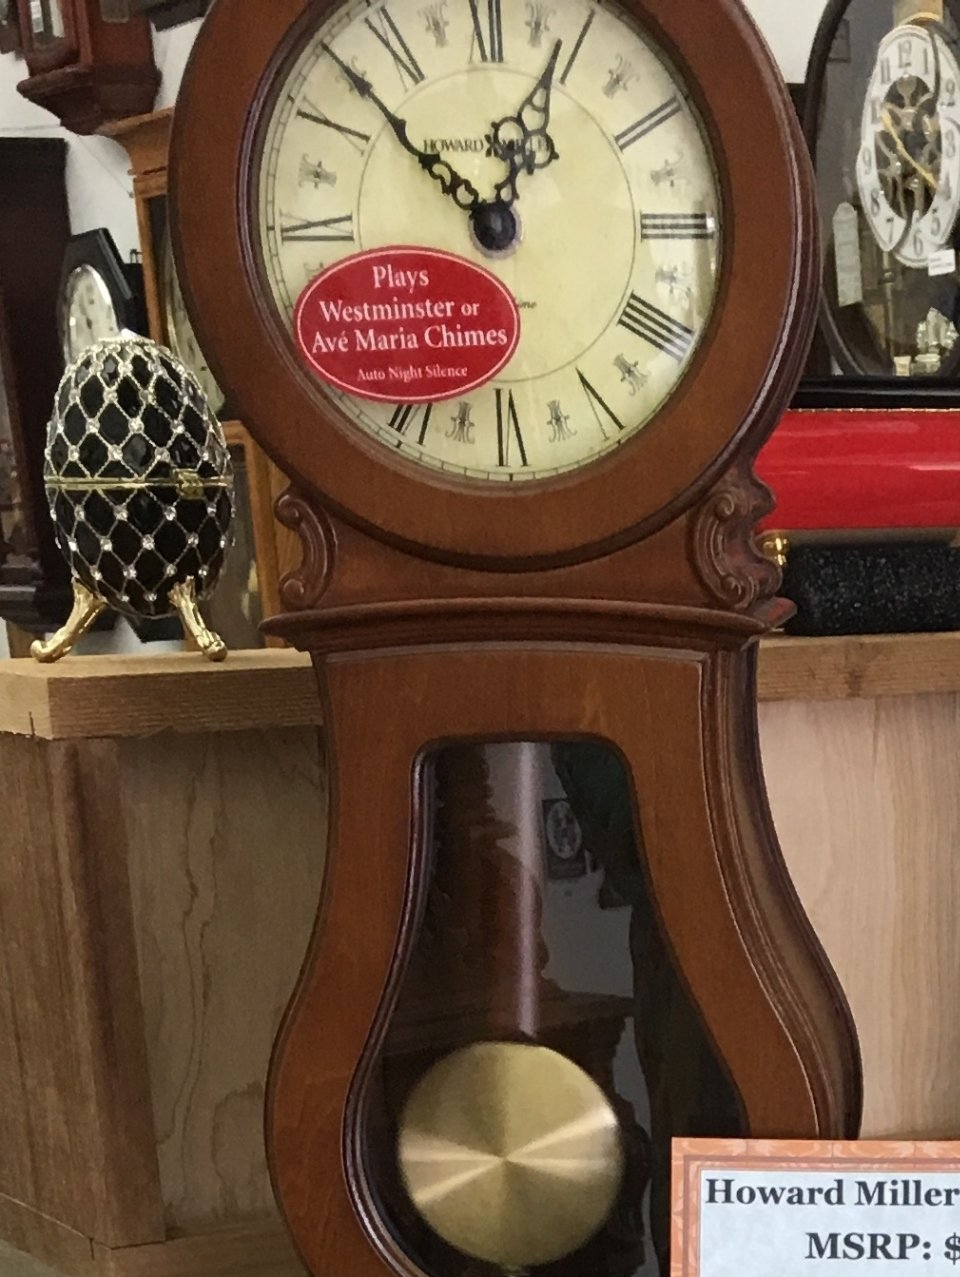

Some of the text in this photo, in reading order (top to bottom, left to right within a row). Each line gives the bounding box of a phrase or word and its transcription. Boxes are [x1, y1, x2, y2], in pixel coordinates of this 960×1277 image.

[423, 139, 484, 152] HOWARD
[372, 264, 429, 294] Plays
[319, 296, 480, 322] Westminster or
[312, 324, 508, 354] Avé Maria Chimes
[357, 363, 468, 383] Auto Night Silence
[705, 1178, 845, 1206] Howard
[855, 1180, 960, 1207] Miller
[804, 1232, 932, 1261] MSRP:
